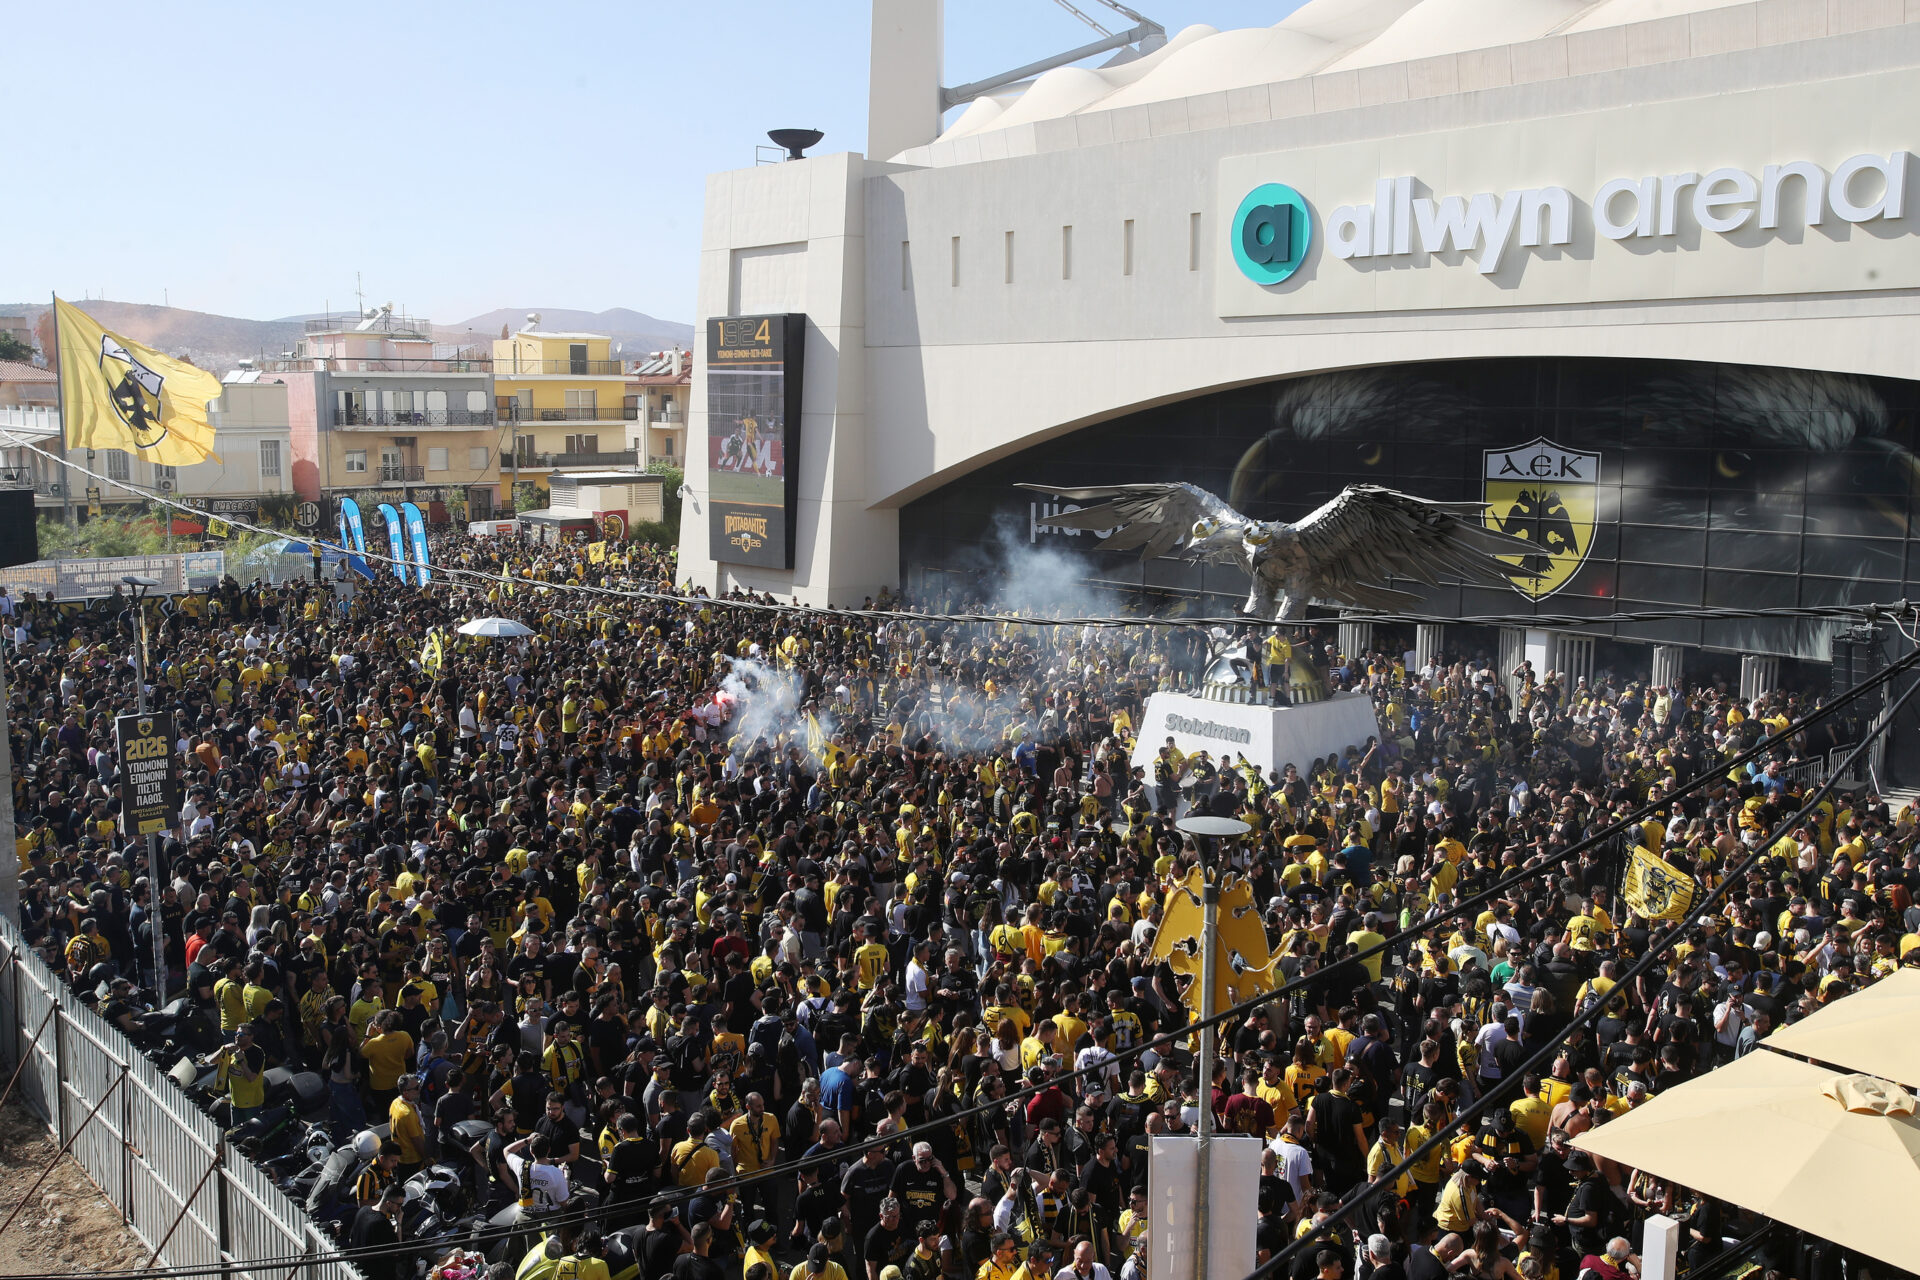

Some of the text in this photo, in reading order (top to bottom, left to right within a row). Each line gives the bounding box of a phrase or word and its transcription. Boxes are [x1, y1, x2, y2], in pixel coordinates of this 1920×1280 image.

[1325, 176, 1573, 274] allwyn
[1592, 151, 1909, 240] arena
[718, 319, 771, 347] 1924
[1165, 713, 1252, 745] Stoiximan
[125, 735, 168, 761] 2026
[127, 758, 169, 774] ΥΠΟΜΟΝΗ
[130, 770, 167, 785] ΕΠΙΜΟΝΗ
[137, 781, 161, 795] ΠΙΣΤΗ
[136, 792, 164, 807] ΠΑΘΟΣ
